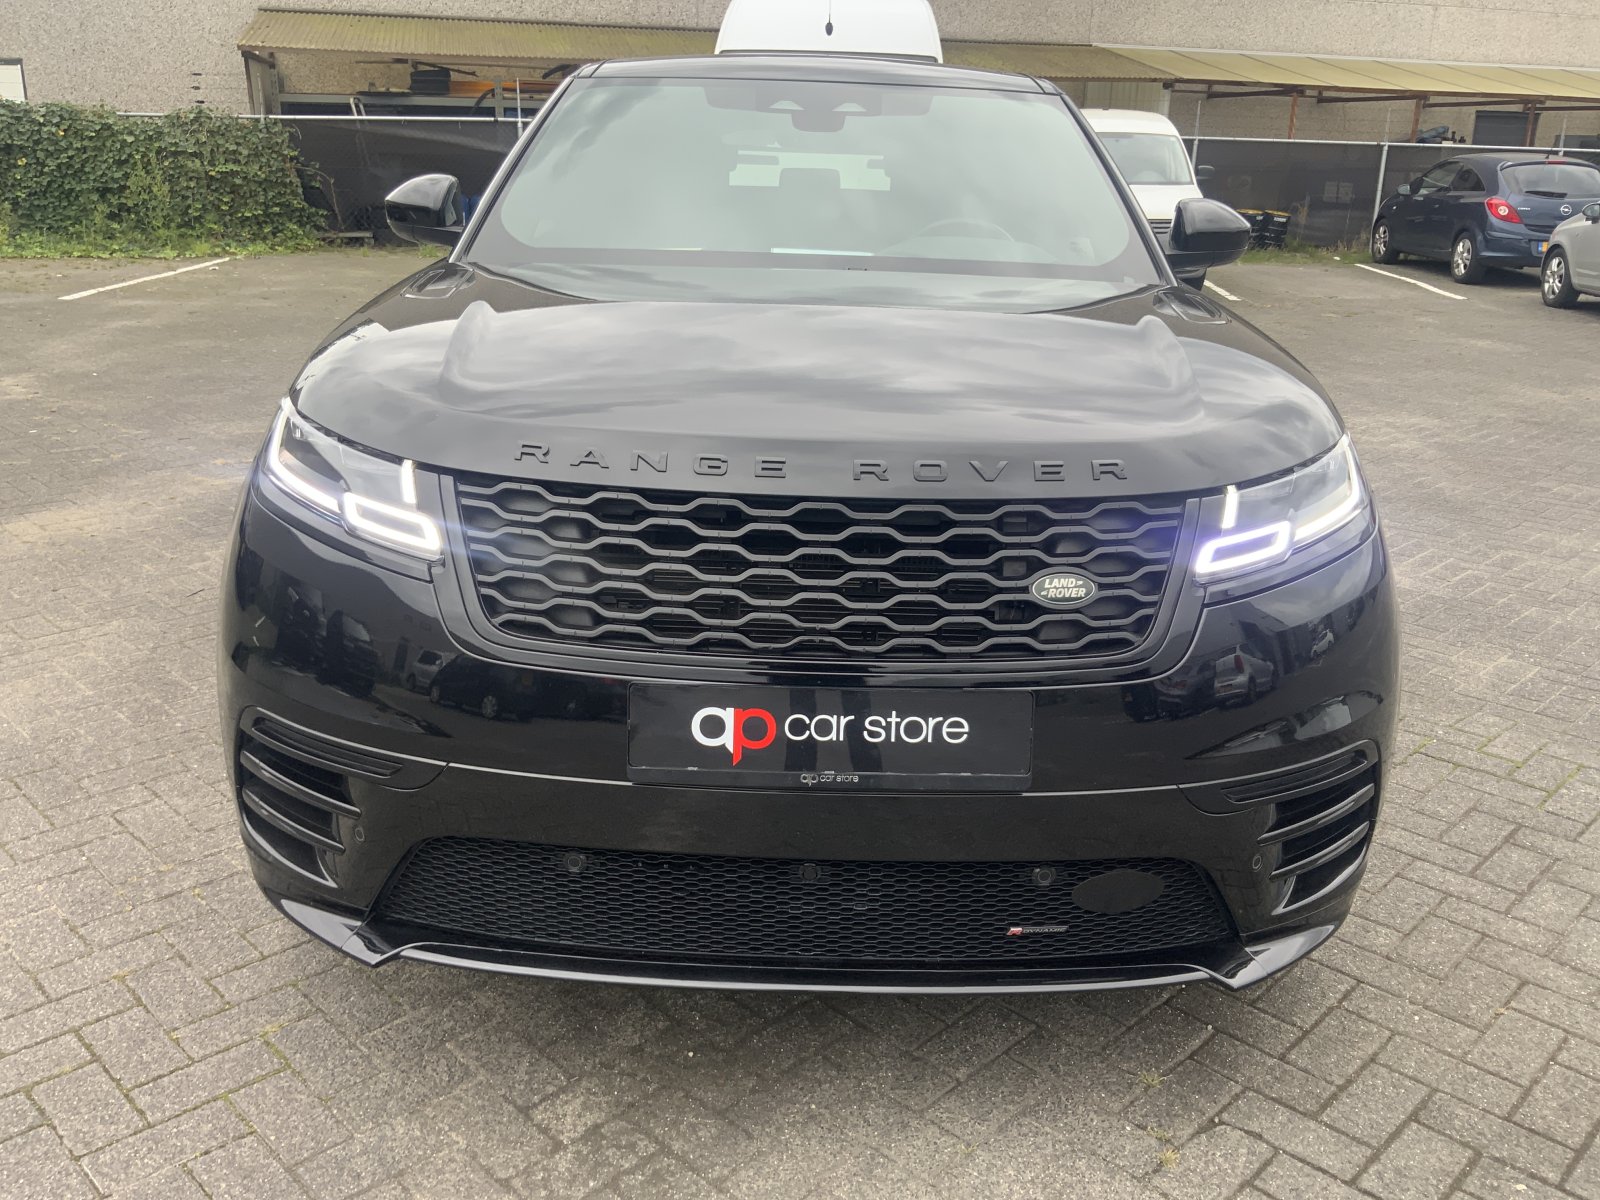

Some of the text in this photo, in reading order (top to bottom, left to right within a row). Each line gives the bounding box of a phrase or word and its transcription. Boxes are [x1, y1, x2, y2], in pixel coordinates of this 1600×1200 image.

[514, 440, 1128, 483] RANGE ROVER
[1044, 578, 1076, 588] LAND
[1047, 588, 1086, 598] ROVER
[784, 713, 855, 742] car
[863, 710, 969, 744] store
[836, 775, 859, 783] store
